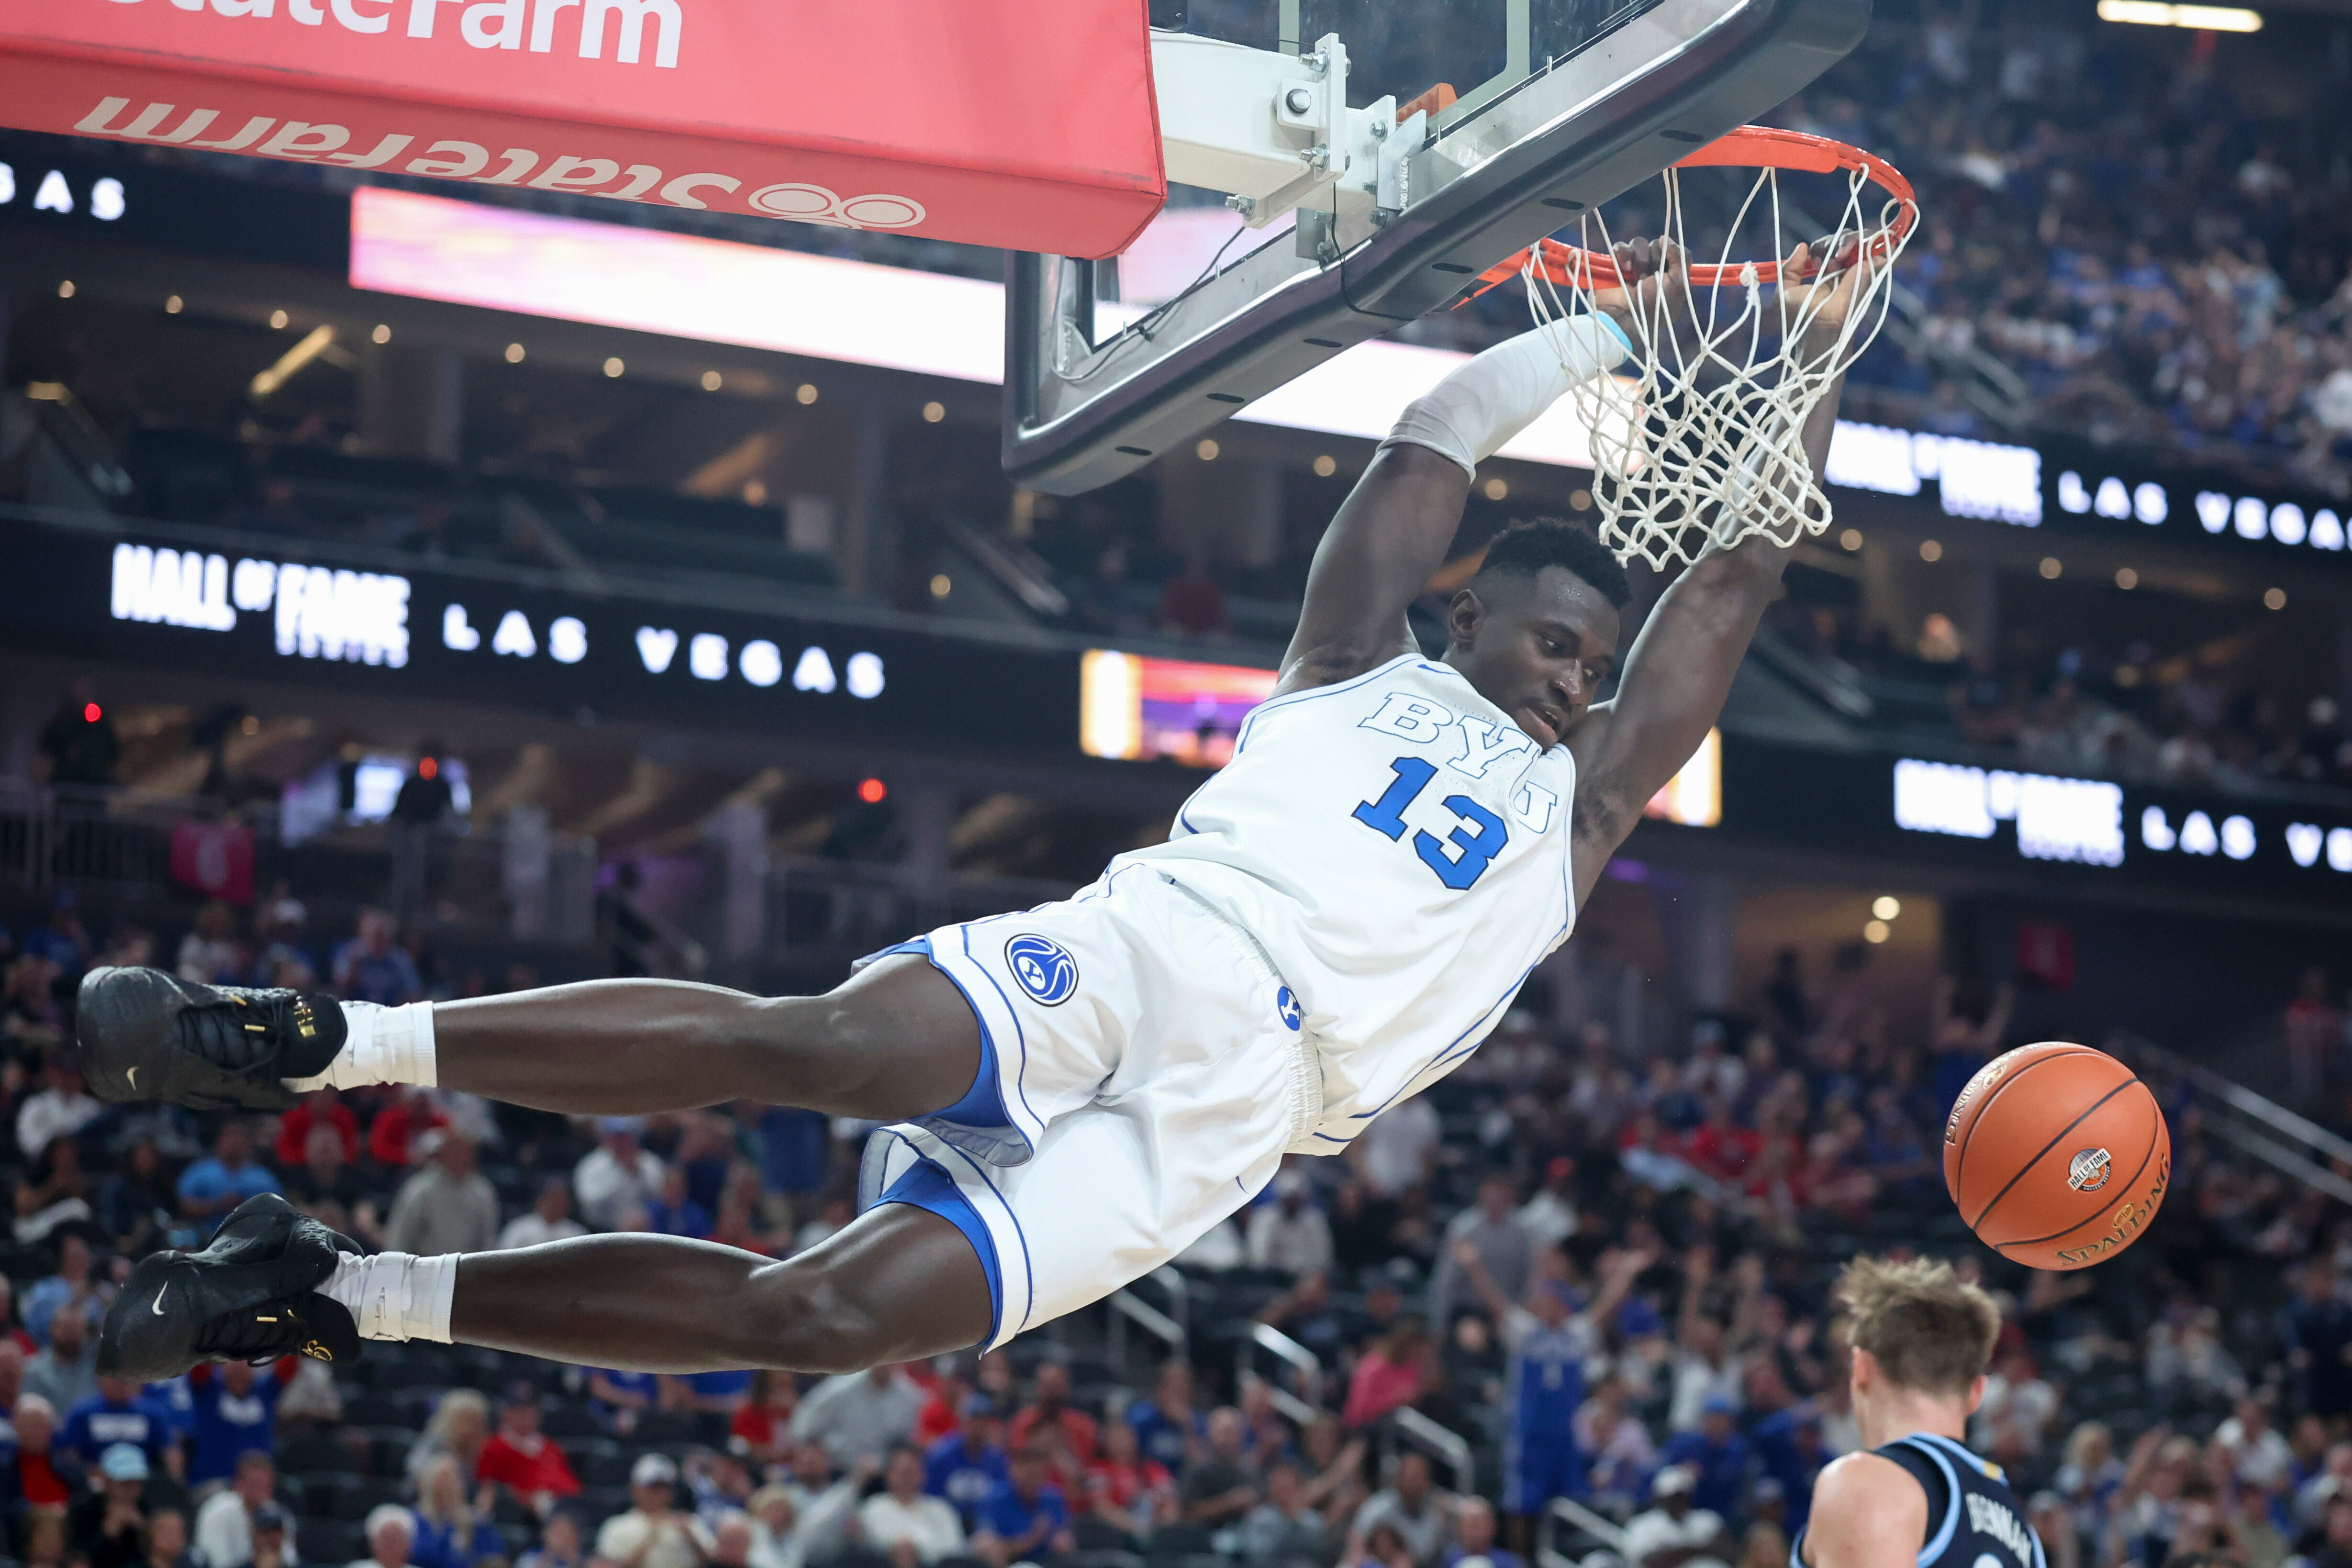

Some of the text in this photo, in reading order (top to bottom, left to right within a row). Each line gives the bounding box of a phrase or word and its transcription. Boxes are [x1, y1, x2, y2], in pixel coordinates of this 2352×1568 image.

[98, 0, 683, 68] eFarm
[73, 96, 743, 209] StateFarm
[2058, 471, 2168, 525] LAS
[2196, 491, 2352, 550] VEGA
[444, 604, 587, 663] LAS
[636, 626, 884, 698] VEGAS
[1357, 692, 1557, 834] BYU
[1351, 756, 1509, 890] 13
[2141, 806, 2256, 860] LAS
[2056, 1153, 2169, 1266] SPALDING
[2070, 1169, 2087, 1188] HALL
[2089, 1151, 2109, 1169] FAME
